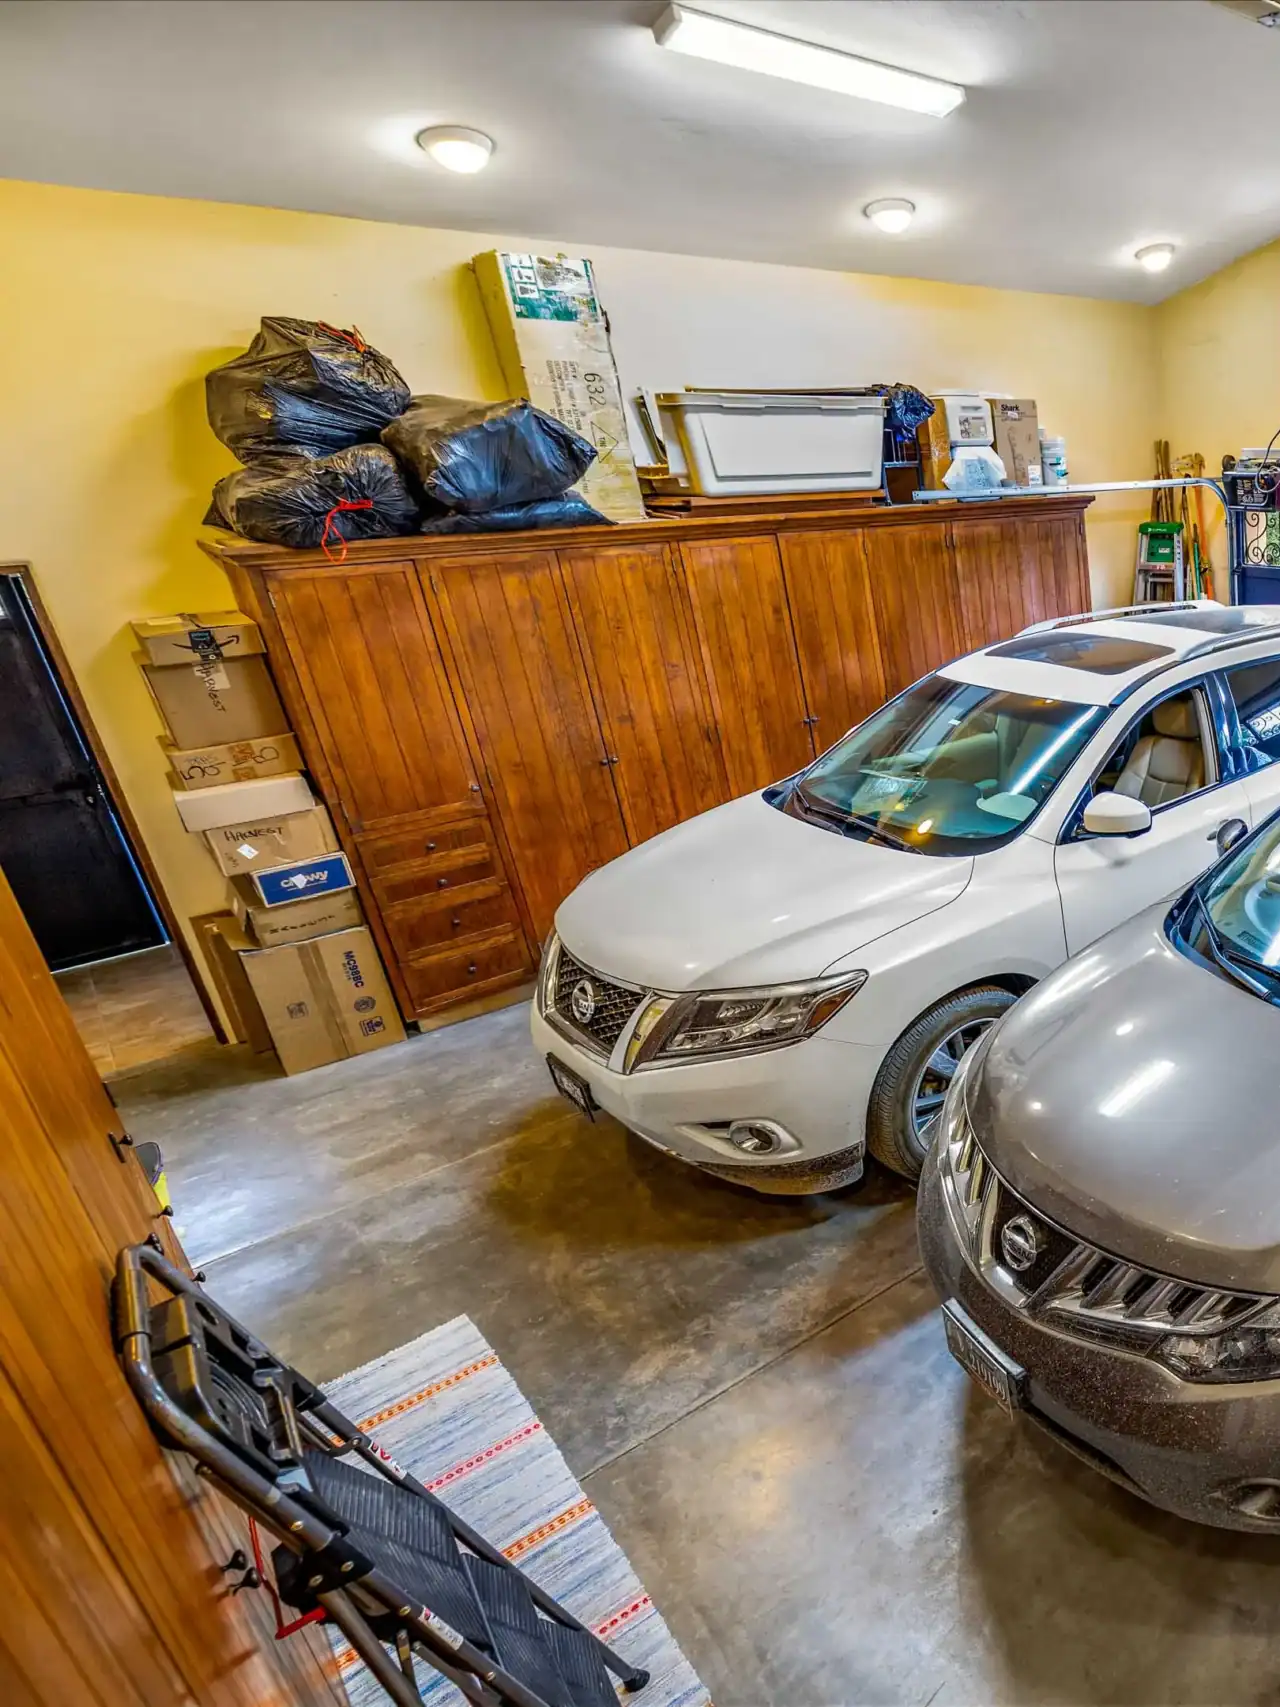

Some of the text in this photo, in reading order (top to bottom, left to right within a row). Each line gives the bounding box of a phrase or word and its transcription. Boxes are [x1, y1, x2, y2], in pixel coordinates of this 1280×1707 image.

[584, 372, 607, 406] 632
[1000, 404, 1020, 412] Shark
[280, 870, 329, 887] chwy
